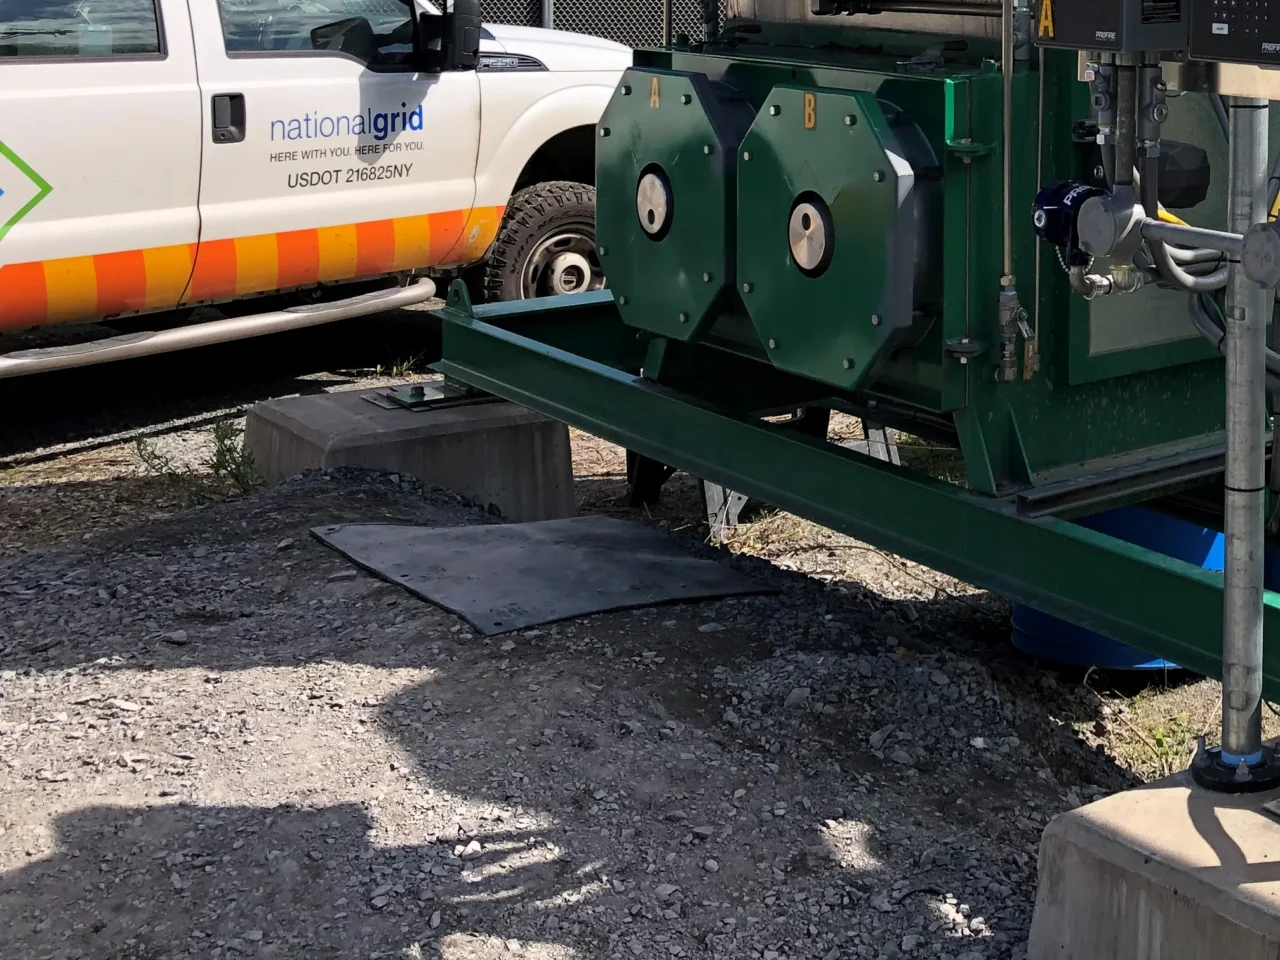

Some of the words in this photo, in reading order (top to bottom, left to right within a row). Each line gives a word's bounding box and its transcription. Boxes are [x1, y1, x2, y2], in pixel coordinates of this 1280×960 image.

[650, 77, 660, 109] A
[271, 101, 423, 141] nationalgrid
[804, 93, 815, 129] B
[269, 150, 298, 163] HERE
[300, 147, 327, 160] WITH
[330, 146, 352, 158] YOU.
[355, 144, 381, 156] HERE
[382, 142, 402, 154] FOR
[405, 141, 425, 151] YOU.
[287, 169, 342, 189] USDOT
[345, 163, 414, 183] 216825NY
